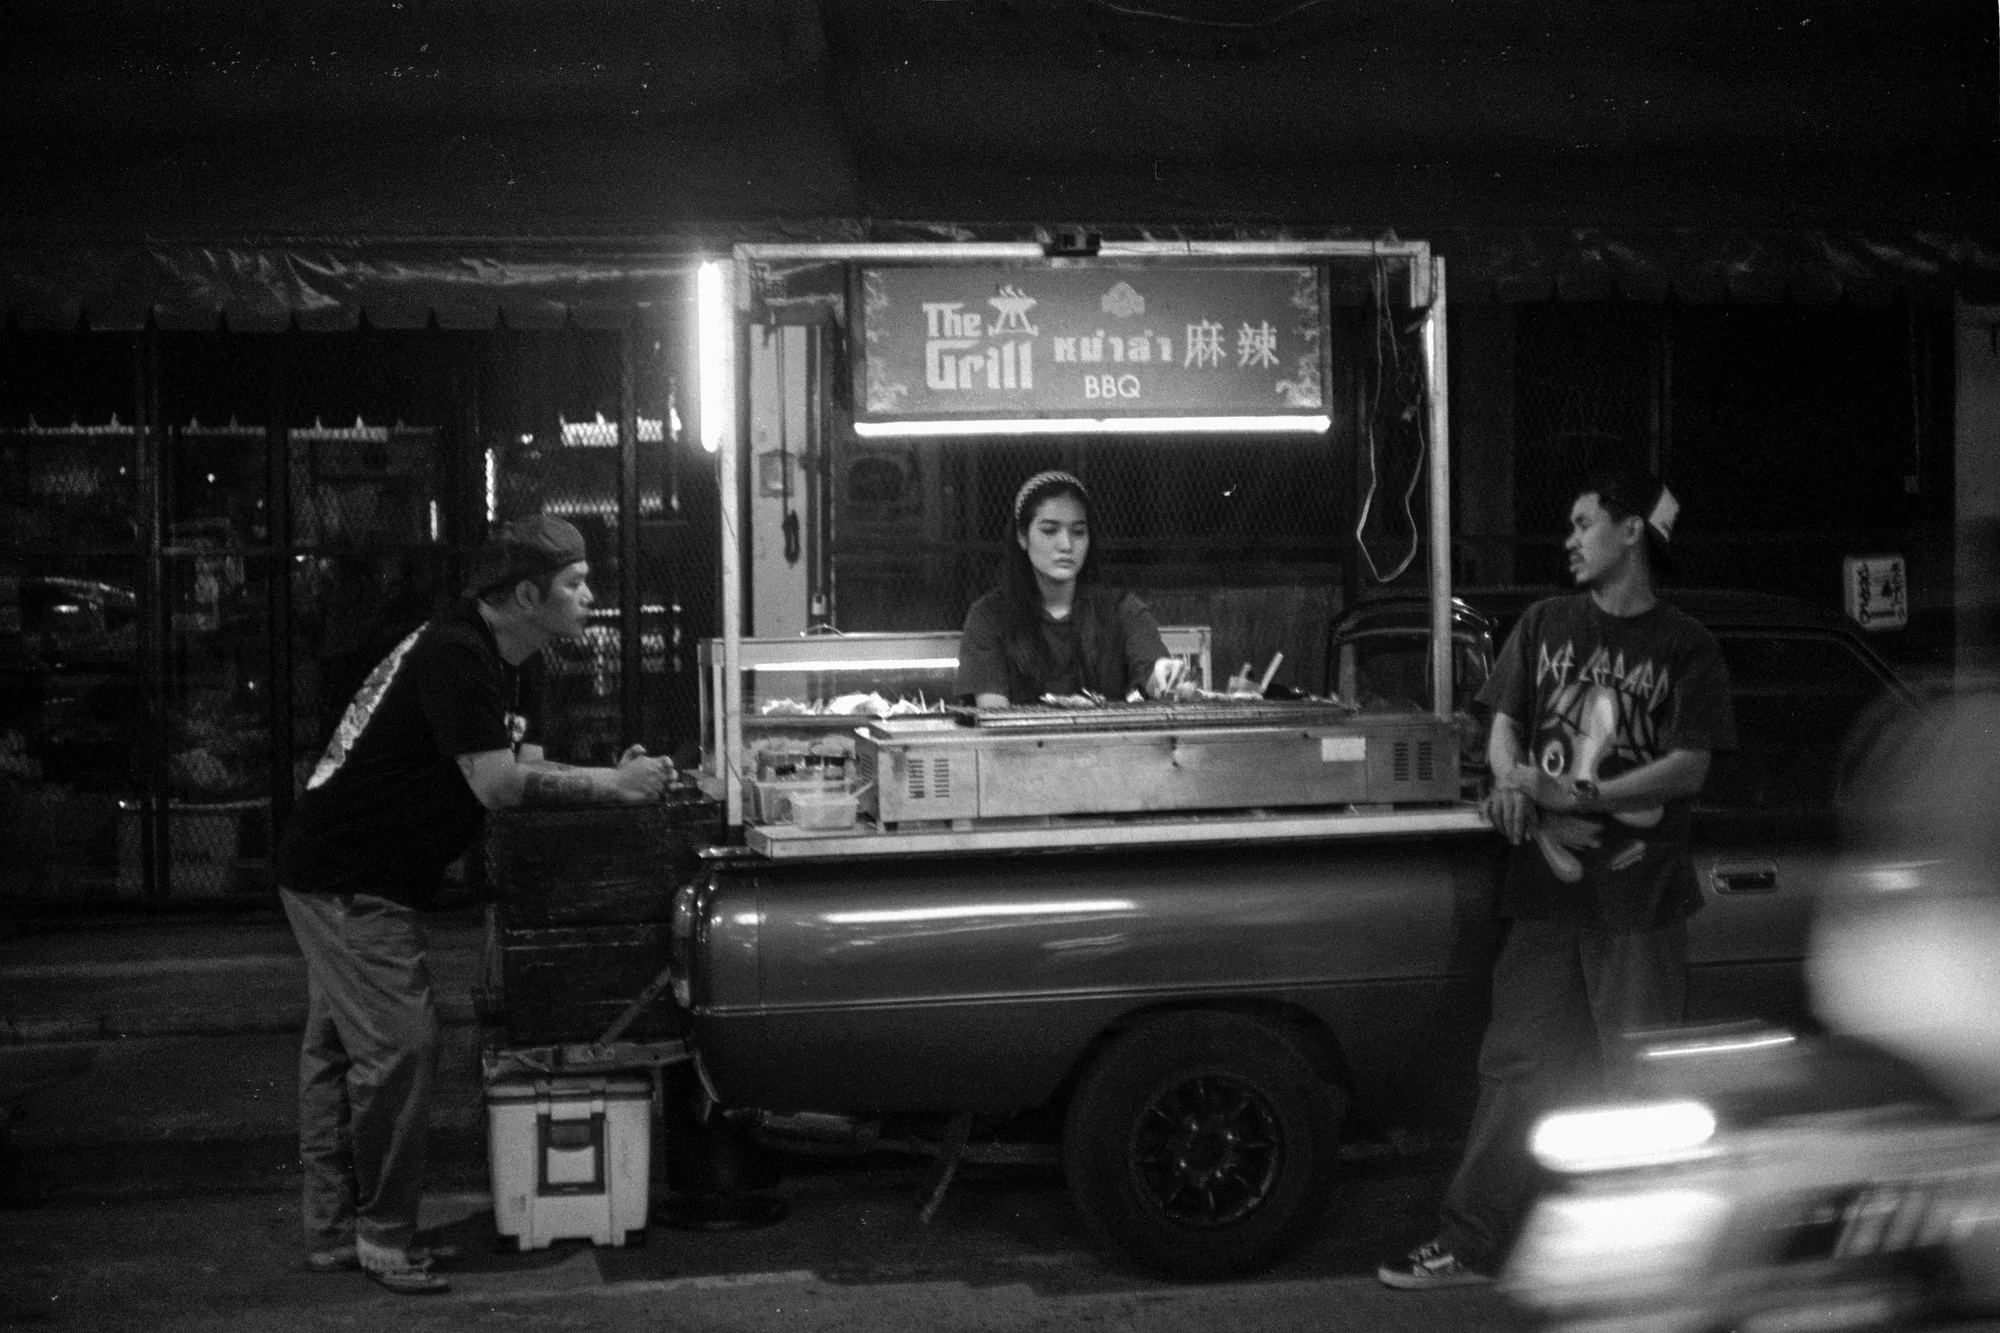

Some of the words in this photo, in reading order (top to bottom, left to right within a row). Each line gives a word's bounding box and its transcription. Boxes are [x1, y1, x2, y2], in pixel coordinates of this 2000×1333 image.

[922, 302, 982, 337] The
[925, 340, 1033, 390] Grill
[1084, 373, 1142, 399] BBQ
